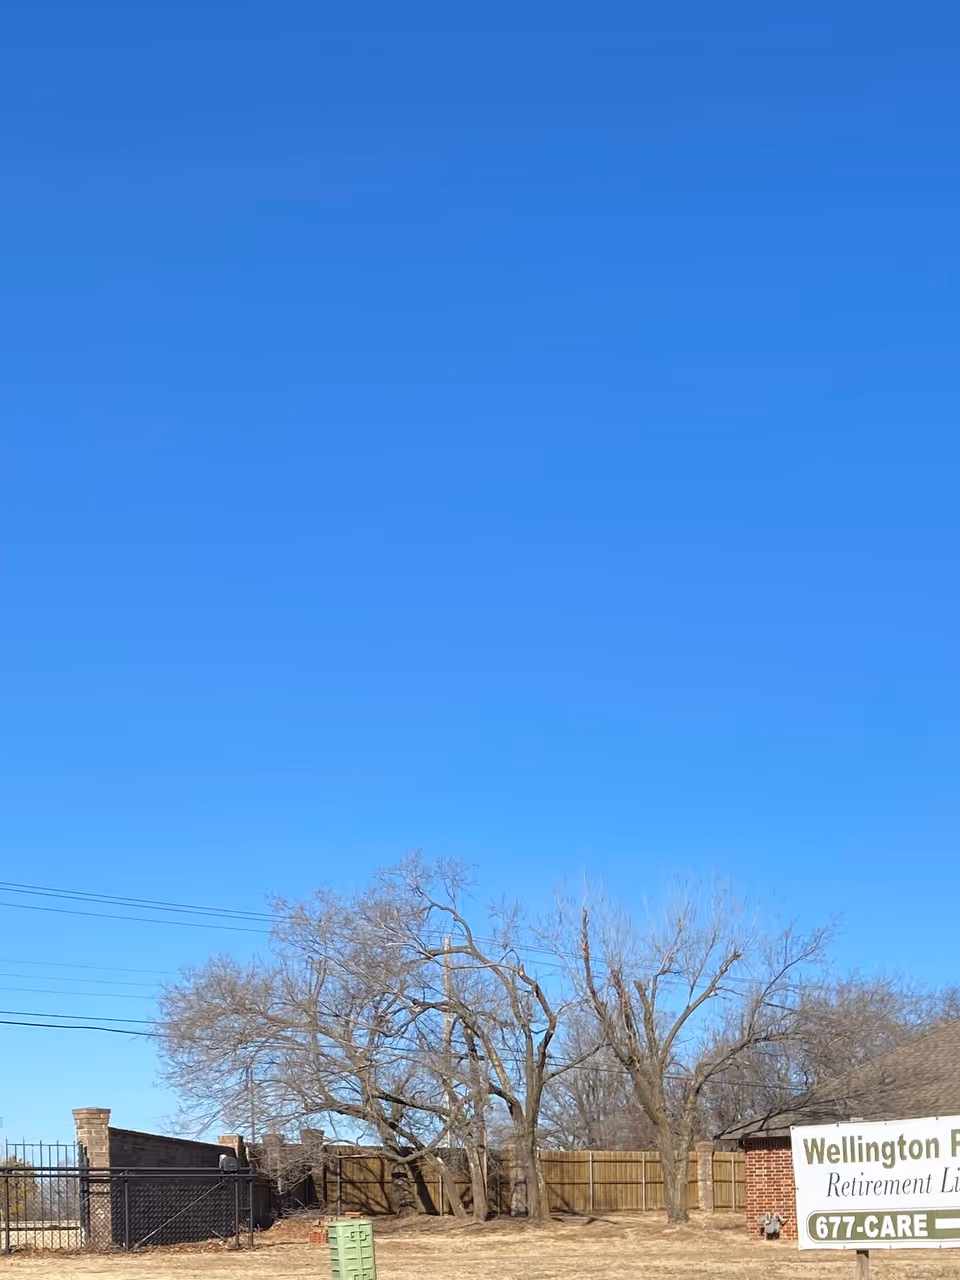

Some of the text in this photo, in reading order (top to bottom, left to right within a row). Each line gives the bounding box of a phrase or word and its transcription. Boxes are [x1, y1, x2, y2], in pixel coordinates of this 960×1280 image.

[803, 1133, 940, 1169] Wellington
[825, 1171, 932, 1197] Retirement
[815, 1213, 928, 1239] 677-CARE
